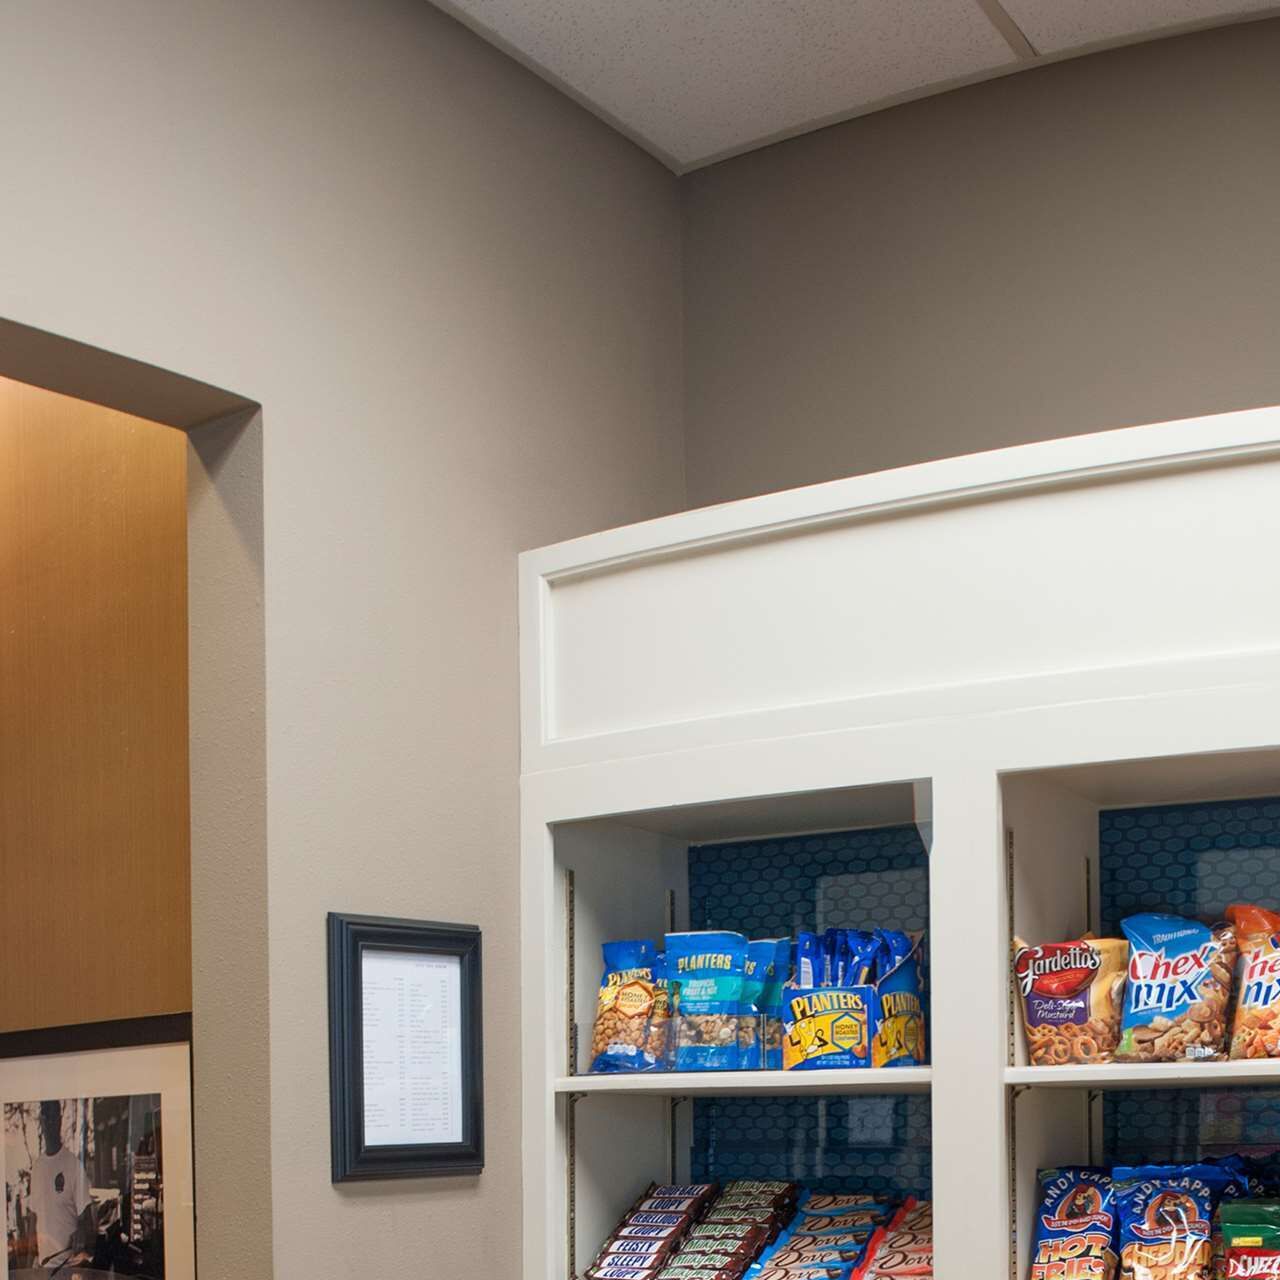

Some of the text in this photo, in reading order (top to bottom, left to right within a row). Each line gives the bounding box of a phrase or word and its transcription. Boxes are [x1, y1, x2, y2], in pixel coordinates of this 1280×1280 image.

[677, 953, 733, 974] PLANTERS
[1015, 946, 1103, 996] Gardetto's
[1130, 944, 1211, 982] Chex
[791, 992, 864, 1020] PLANTERS
[1044, 1170, 1076, 1208] ANDY
[1132, 1178, 1162, 1215] ANDY
[649, 1199, 685, 1210] LOOPY
[627, 1226, 664, 1236] LOOPY
[806, 1215, 865, 1232] Dove
[617, 1240, 658, 1252] FEISTY
[790, 1235, 849, 1251] Dove
[1038, 1233, 1110, 1258] HOT
[607, 1254, 650, 1267] SLEEPY
[775, 1251, 832, 1267] Dove
[602, 1268, 642, 1279] LOOPY
